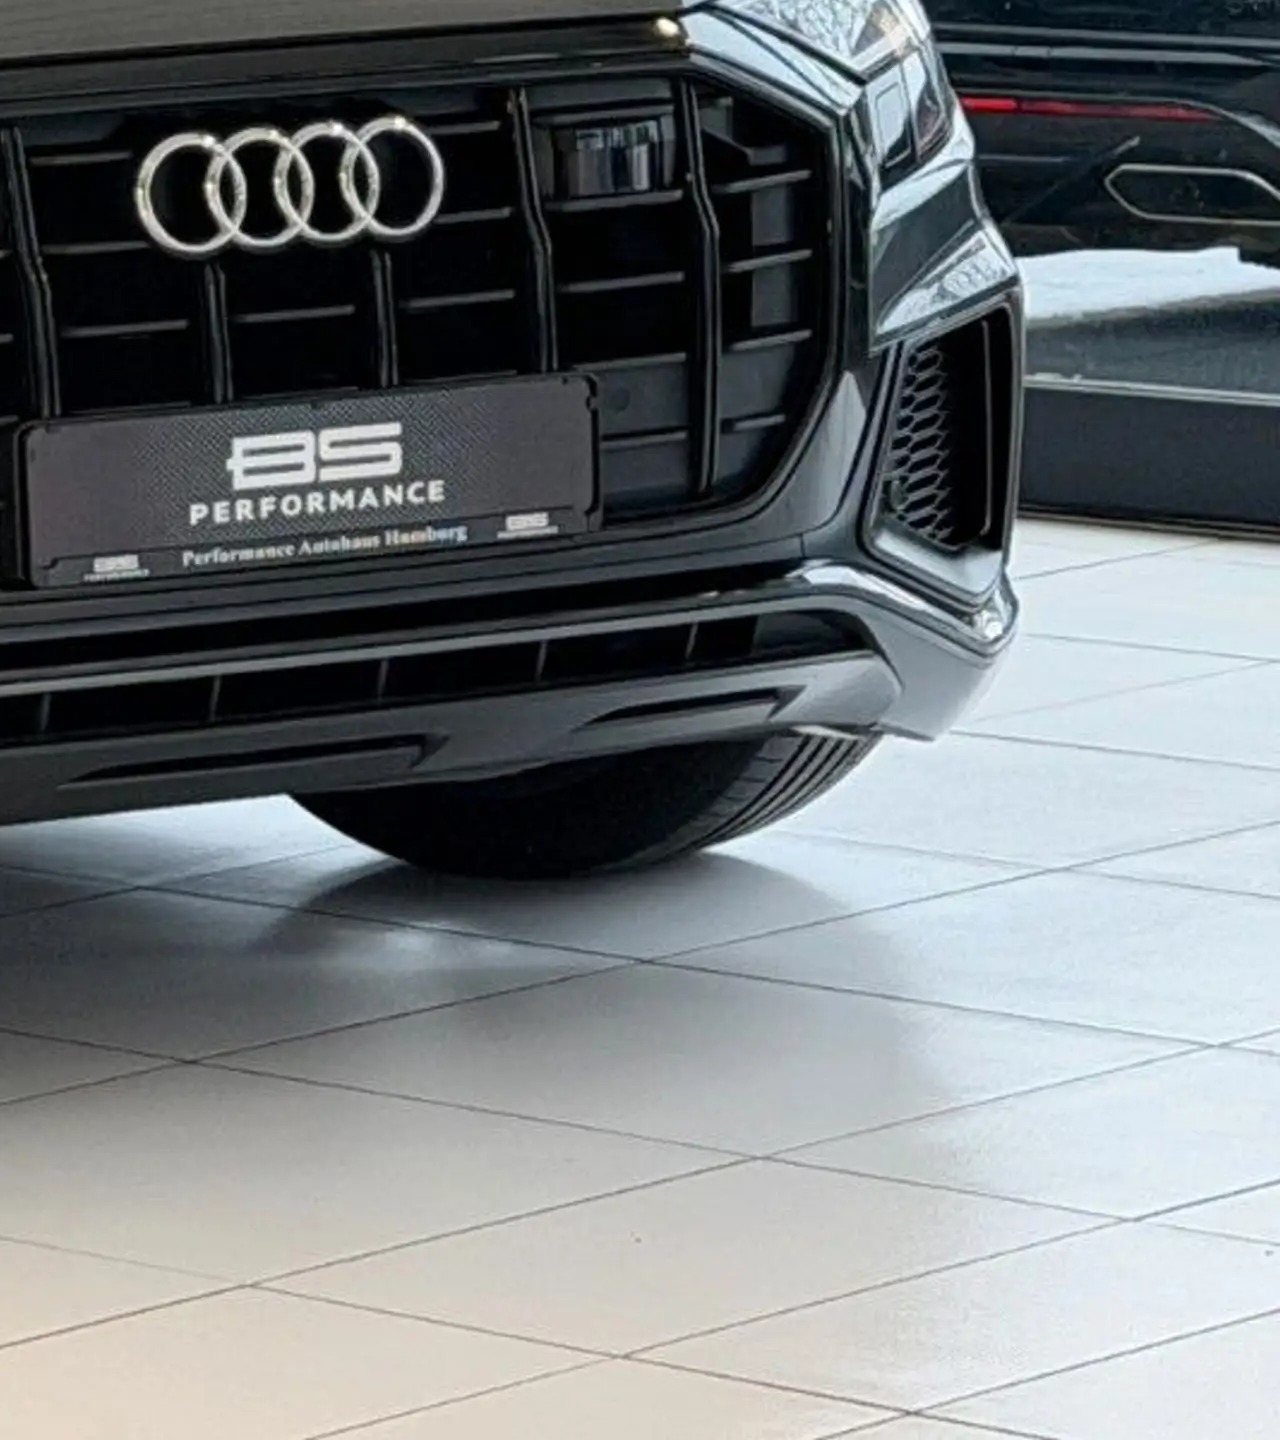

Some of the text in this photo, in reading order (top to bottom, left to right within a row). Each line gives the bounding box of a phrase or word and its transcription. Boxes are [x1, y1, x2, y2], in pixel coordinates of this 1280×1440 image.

[189, 479, 446, 525] PERFORMANCE
[182, 525, 468, 567] Performance Autohaus Hamburg
